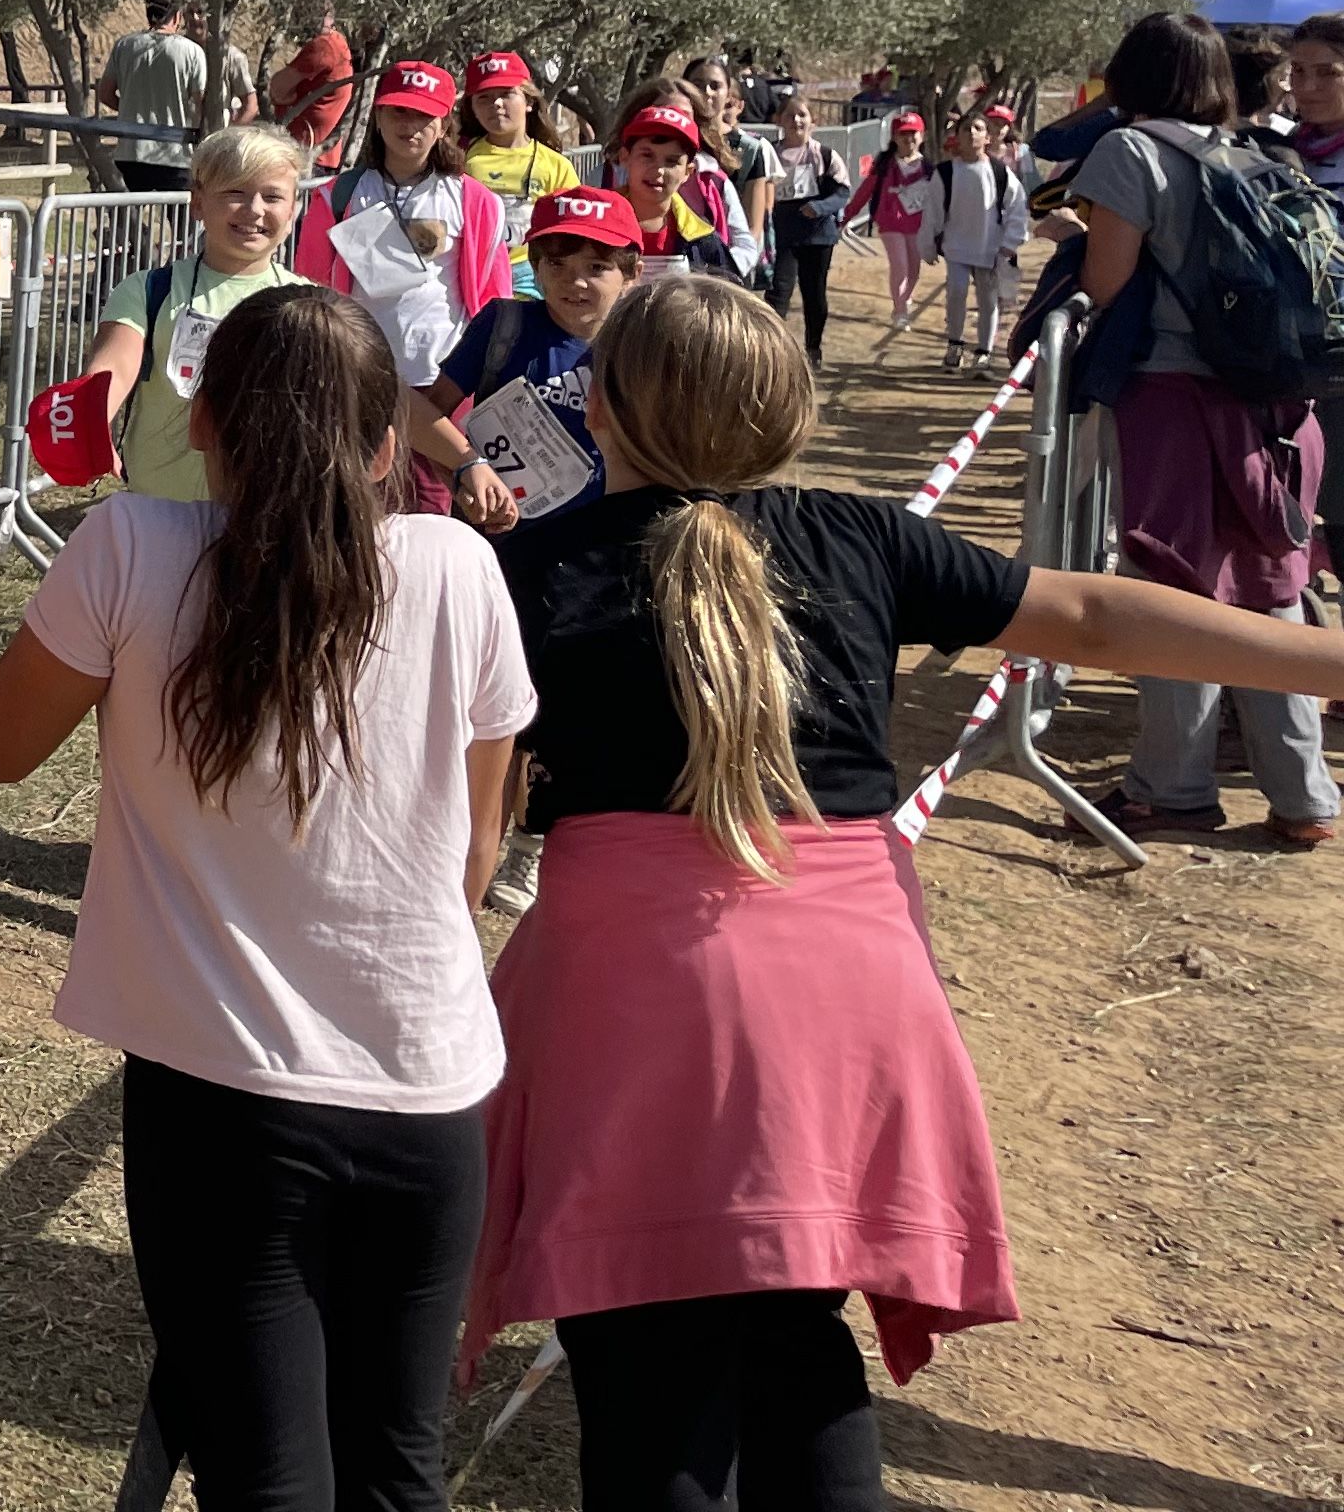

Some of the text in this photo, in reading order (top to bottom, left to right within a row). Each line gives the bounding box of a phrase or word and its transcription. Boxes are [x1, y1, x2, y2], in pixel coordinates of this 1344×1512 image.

[478, 58, 510, 75] TOT
[401, 69, 441, 93] TOT
[653, 107, 692, 128] TOT
[554, 195, 613, 220] TOT
[49, 391, 76, 445] TOT
[483, 434, 526, 473] 87
